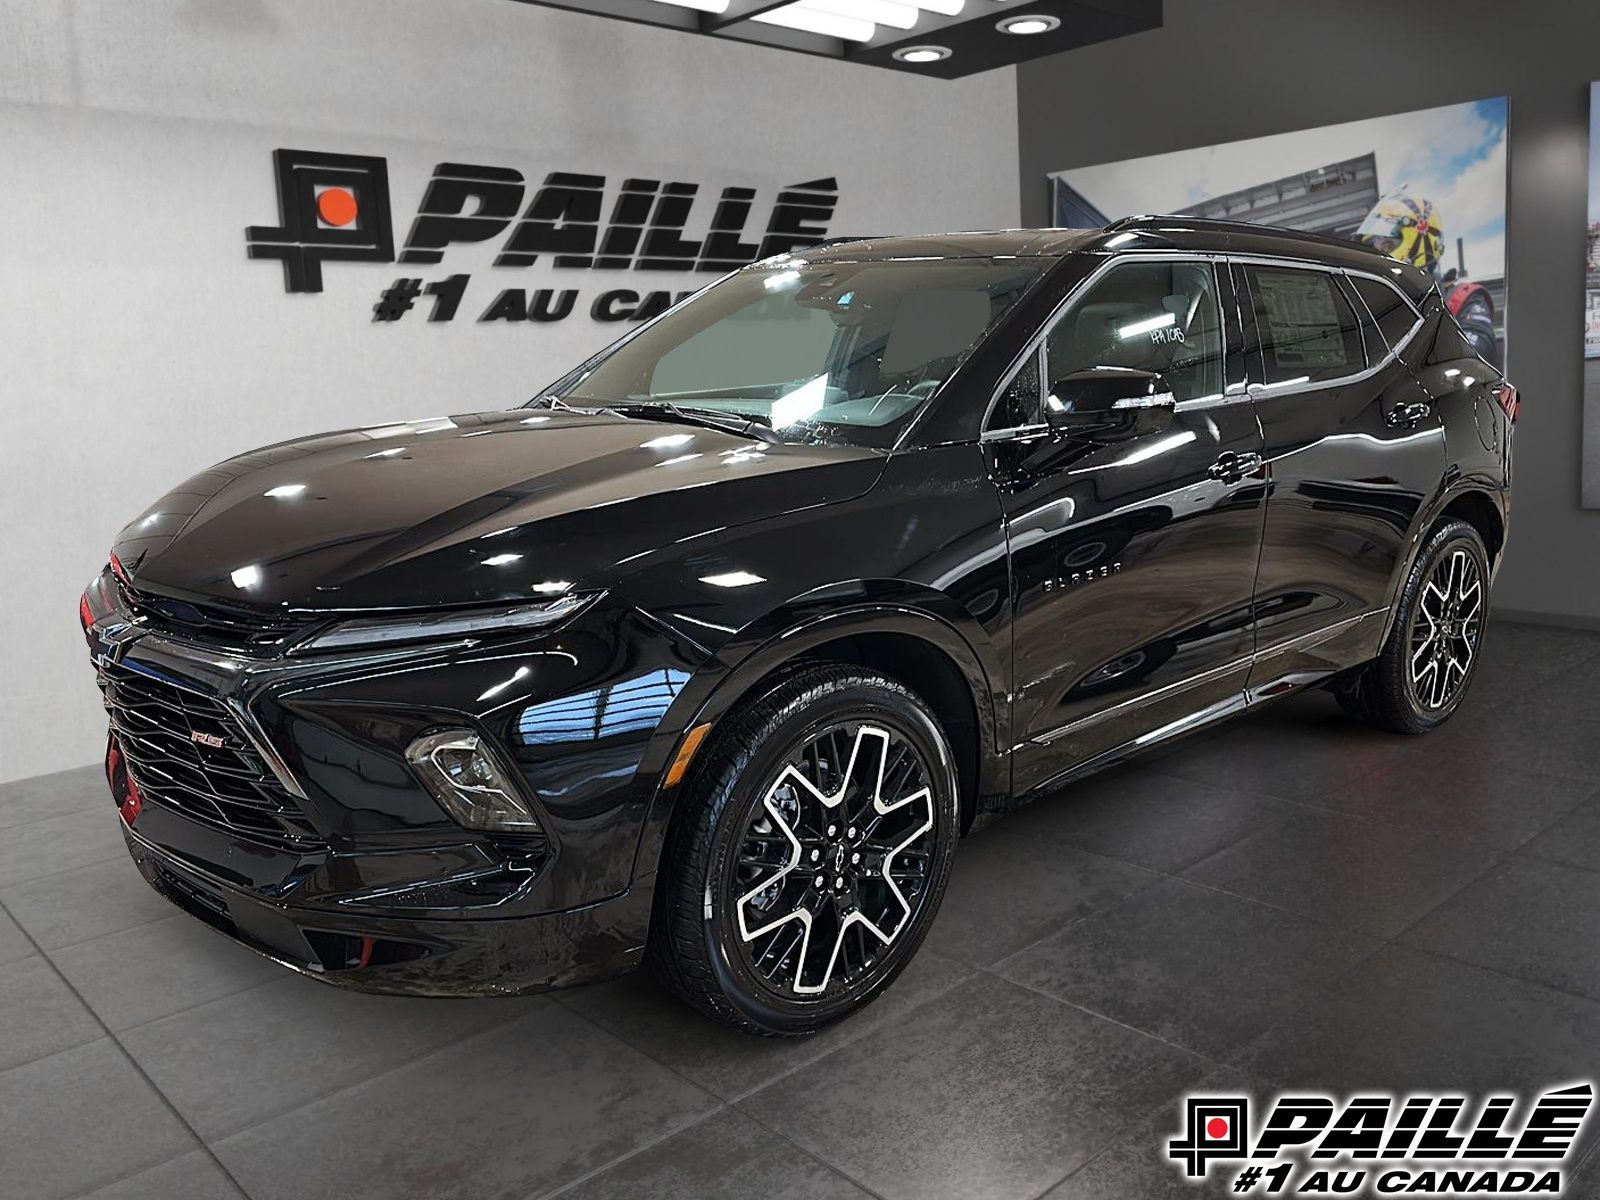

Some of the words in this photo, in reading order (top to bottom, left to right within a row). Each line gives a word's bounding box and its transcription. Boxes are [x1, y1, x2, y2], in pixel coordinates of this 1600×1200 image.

[397, 162, 839, 273] PAILLÉ
[371, 274, 472, 323] #1
[476, 288, 580, 323] AU
[191, 730, 223, 748] RS
